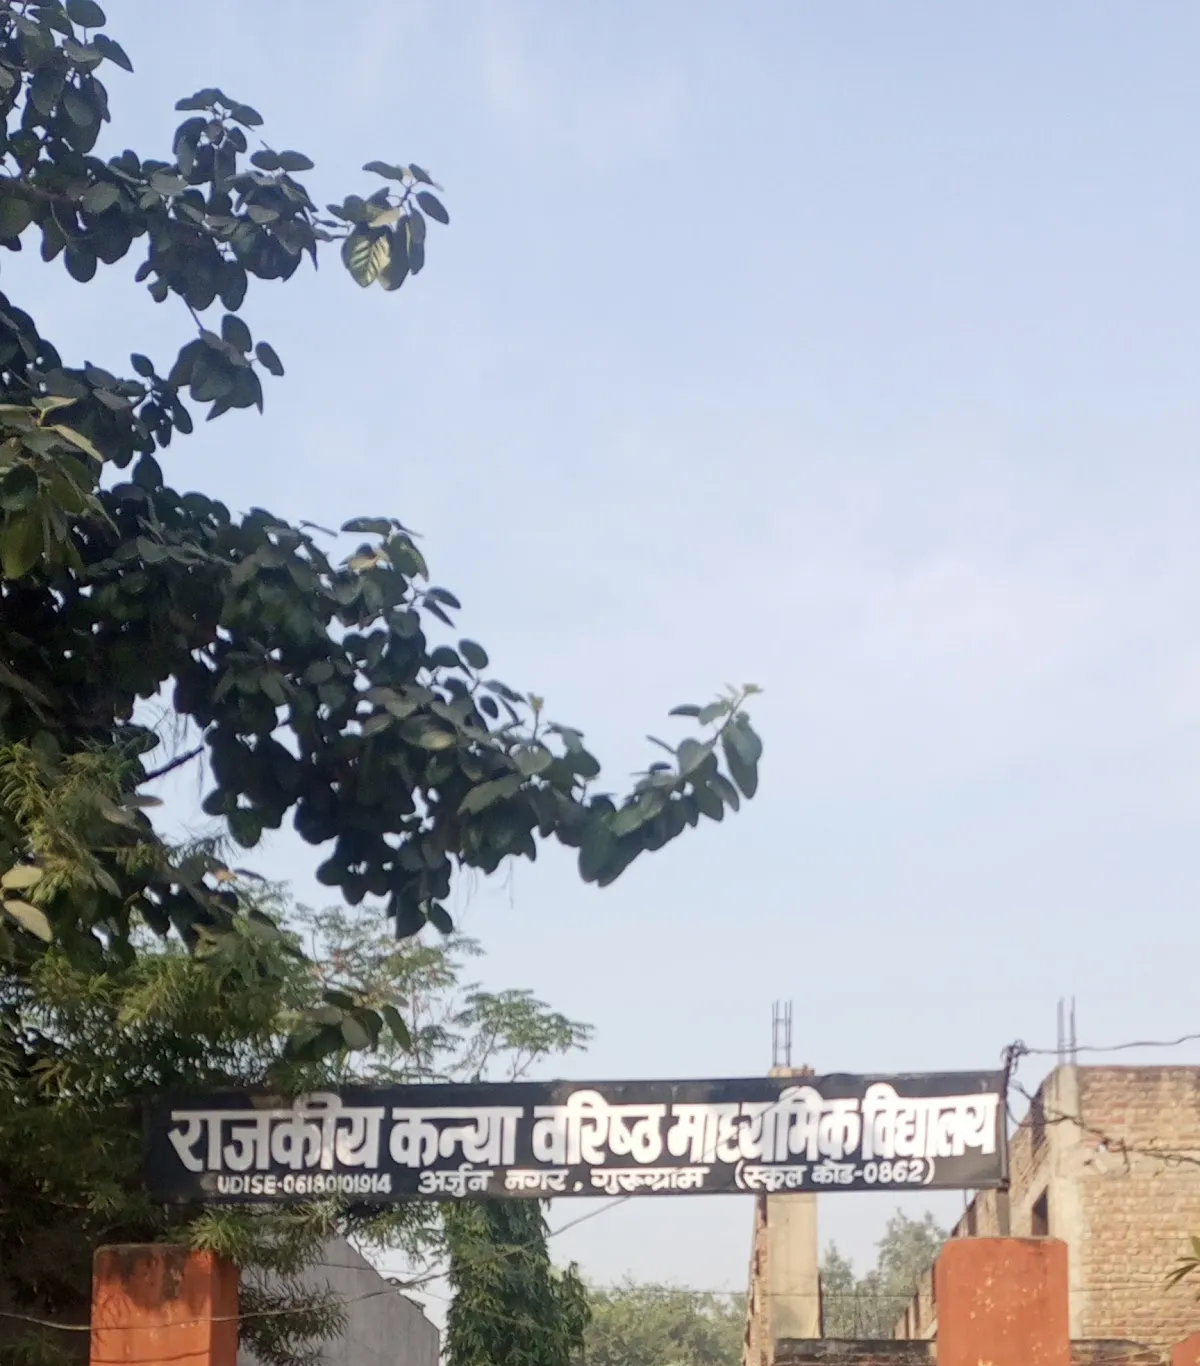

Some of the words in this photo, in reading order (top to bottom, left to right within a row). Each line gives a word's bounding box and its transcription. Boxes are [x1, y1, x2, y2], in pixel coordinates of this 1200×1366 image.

[168, 1092, 385, 1172] राजकीय
[389, 1106, 523, 1168] कन्या
[532, 1090, 666, 1165] वरिष्ठ
[667, 1086, 860, 1164] माध्यमिक
[862, 1083, 999, 1159] विद्यालय
[418, 1163, 494, 1197] अर्जुन
